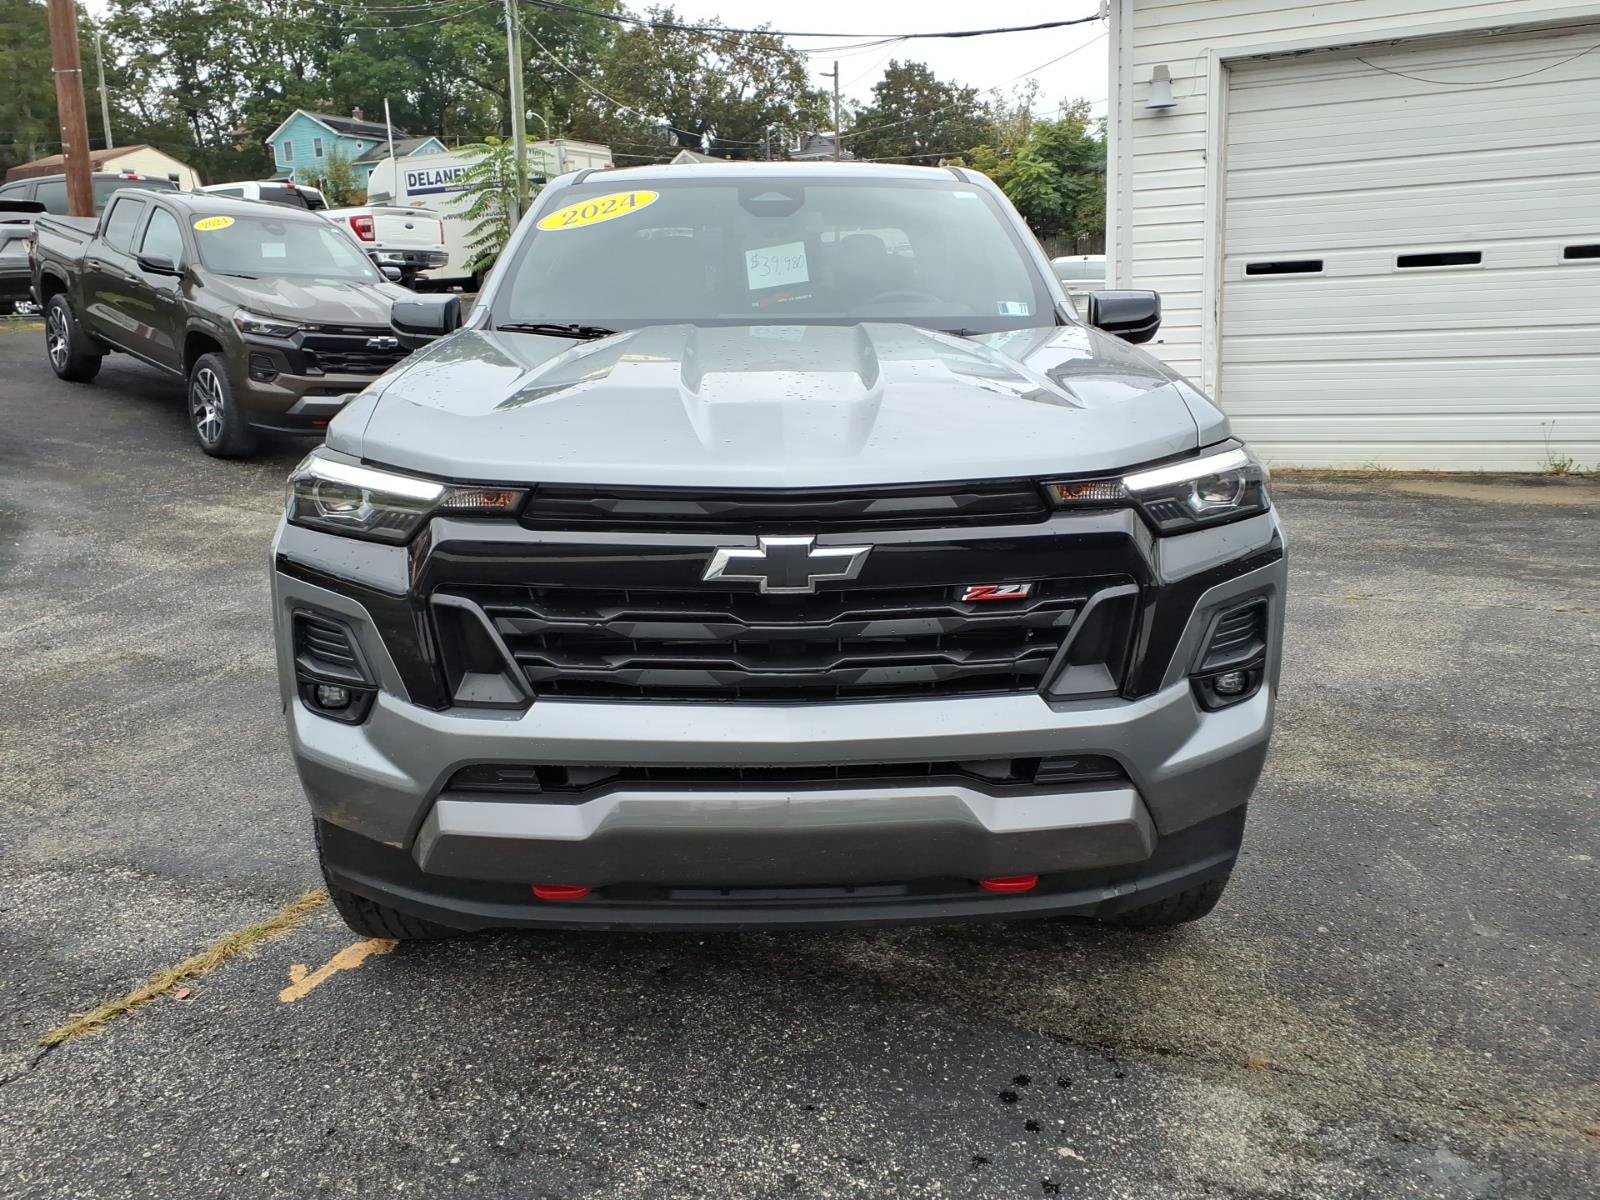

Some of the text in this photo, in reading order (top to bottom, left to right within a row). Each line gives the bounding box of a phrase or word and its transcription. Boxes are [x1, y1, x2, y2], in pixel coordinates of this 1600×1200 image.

[407, 167, 471, 188] DELANE
[562, 194, 635, 225] 2024
[961, 584, 1031, 601] Z71
